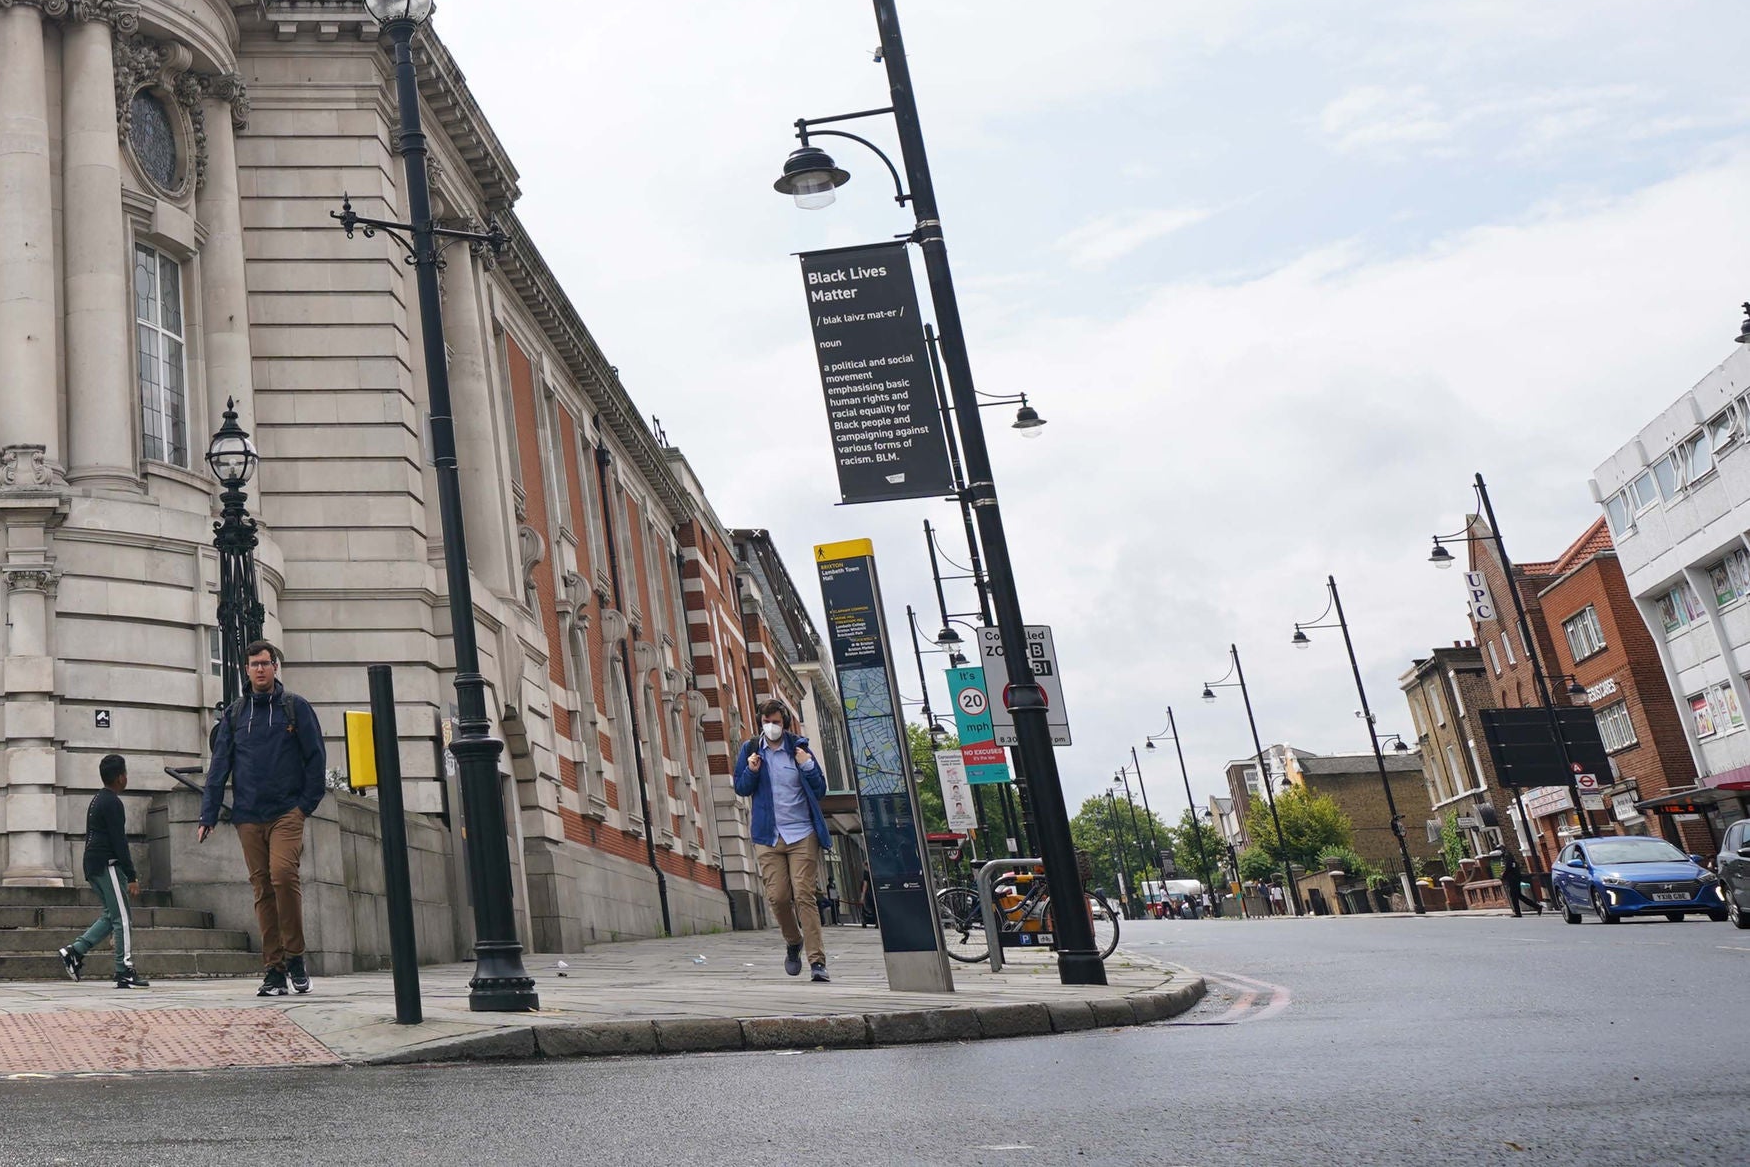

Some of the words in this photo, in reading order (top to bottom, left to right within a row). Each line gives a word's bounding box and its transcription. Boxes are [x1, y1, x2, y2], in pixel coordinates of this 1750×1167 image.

[808, 269, 847, 284] Black
[850, 266, 887, 280] Lives
[811, 288, 858, 303] Matter
[823, 316, 842, 325] blak
[844, 314, 865, 323] laivz
[867, 310, 897, 319] mat-er
[819, 339, 842, 349] noun
[831, 360, 867, 372] political
[869, 357, 886, 367] and
[888, 354, 914, 365] social
[826, 371, 873, 383] movement
[828, 383, 885, 395] emphasising
[886, 379, 910, 389] basic
[830, 397, 861, 407] human
[863, 394, 890, 405] rights
[892, 391, 909, 400] and
[832, 408, 858, 418] racial
[859, 404, 895, 416] equality
[897, 403, 910, 412] for
[834, 421, 859, 430] Black
[861, 417, 891, 429] people
[893, 415, 910, 424] and
[836, 430, 894, 442] campaigning
[895, 426, 929, 437] against
[838, 444, 872, 453] various
[874, 441, 901, 451] forms
[903, 439, 912, 447] of
[840, 456, 874, 466] racism.
[876, 452, 900, 462] BLM.
[1466, 573, 1491, 618] UPC
[1033, 645, 1042, 656] B
[959, 672, 975, 681] It's
[963, 694, 982, 708] 20
[966, 722, 990, 733] mph
[1573, 764, 1581, 772] A
